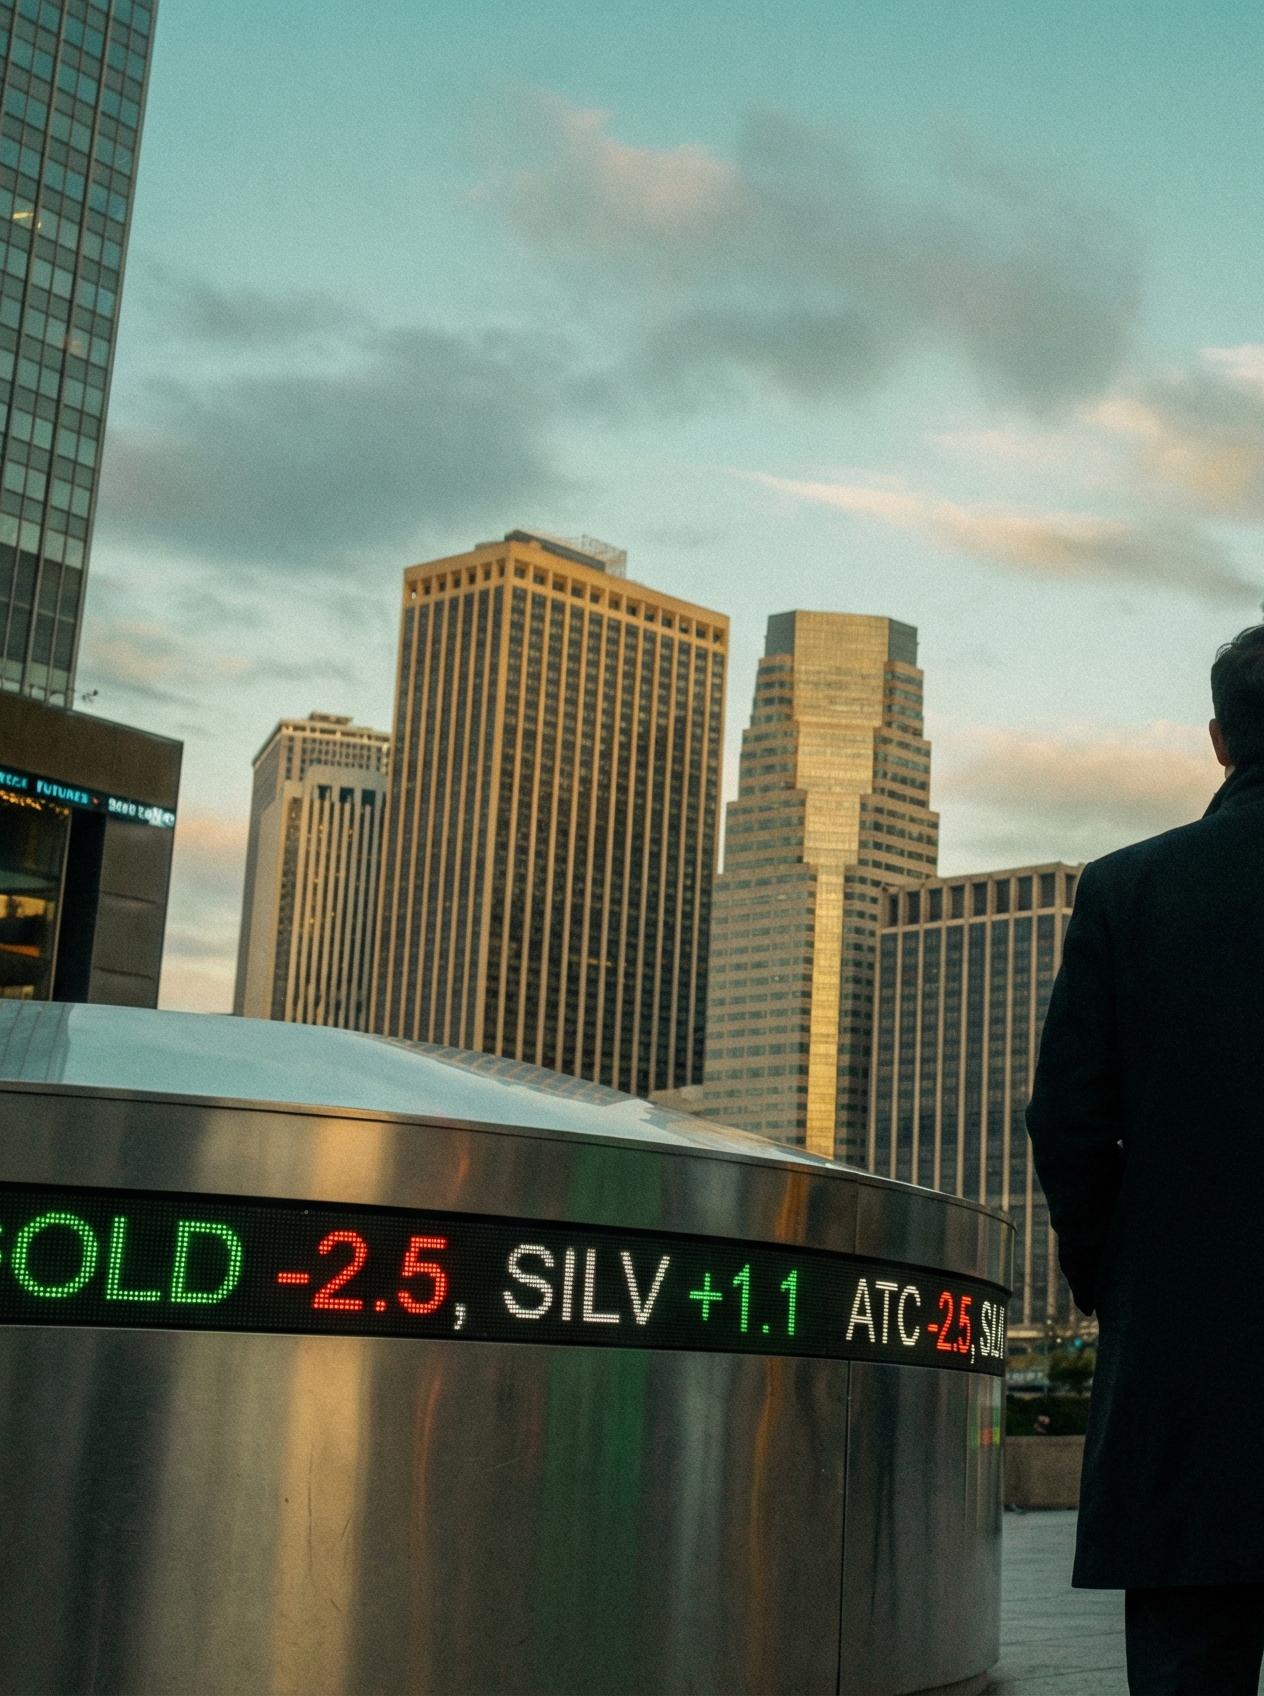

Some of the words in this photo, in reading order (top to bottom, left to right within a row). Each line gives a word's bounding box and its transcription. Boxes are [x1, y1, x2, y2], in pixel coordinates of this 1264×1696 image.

[0, 1212, 243, 1304] OLD
[276, 1230, 466, 1330] -2.5,
[502, 1244, 671, 1325] SILV
[689, 1264, 799, 1335] +1.1
